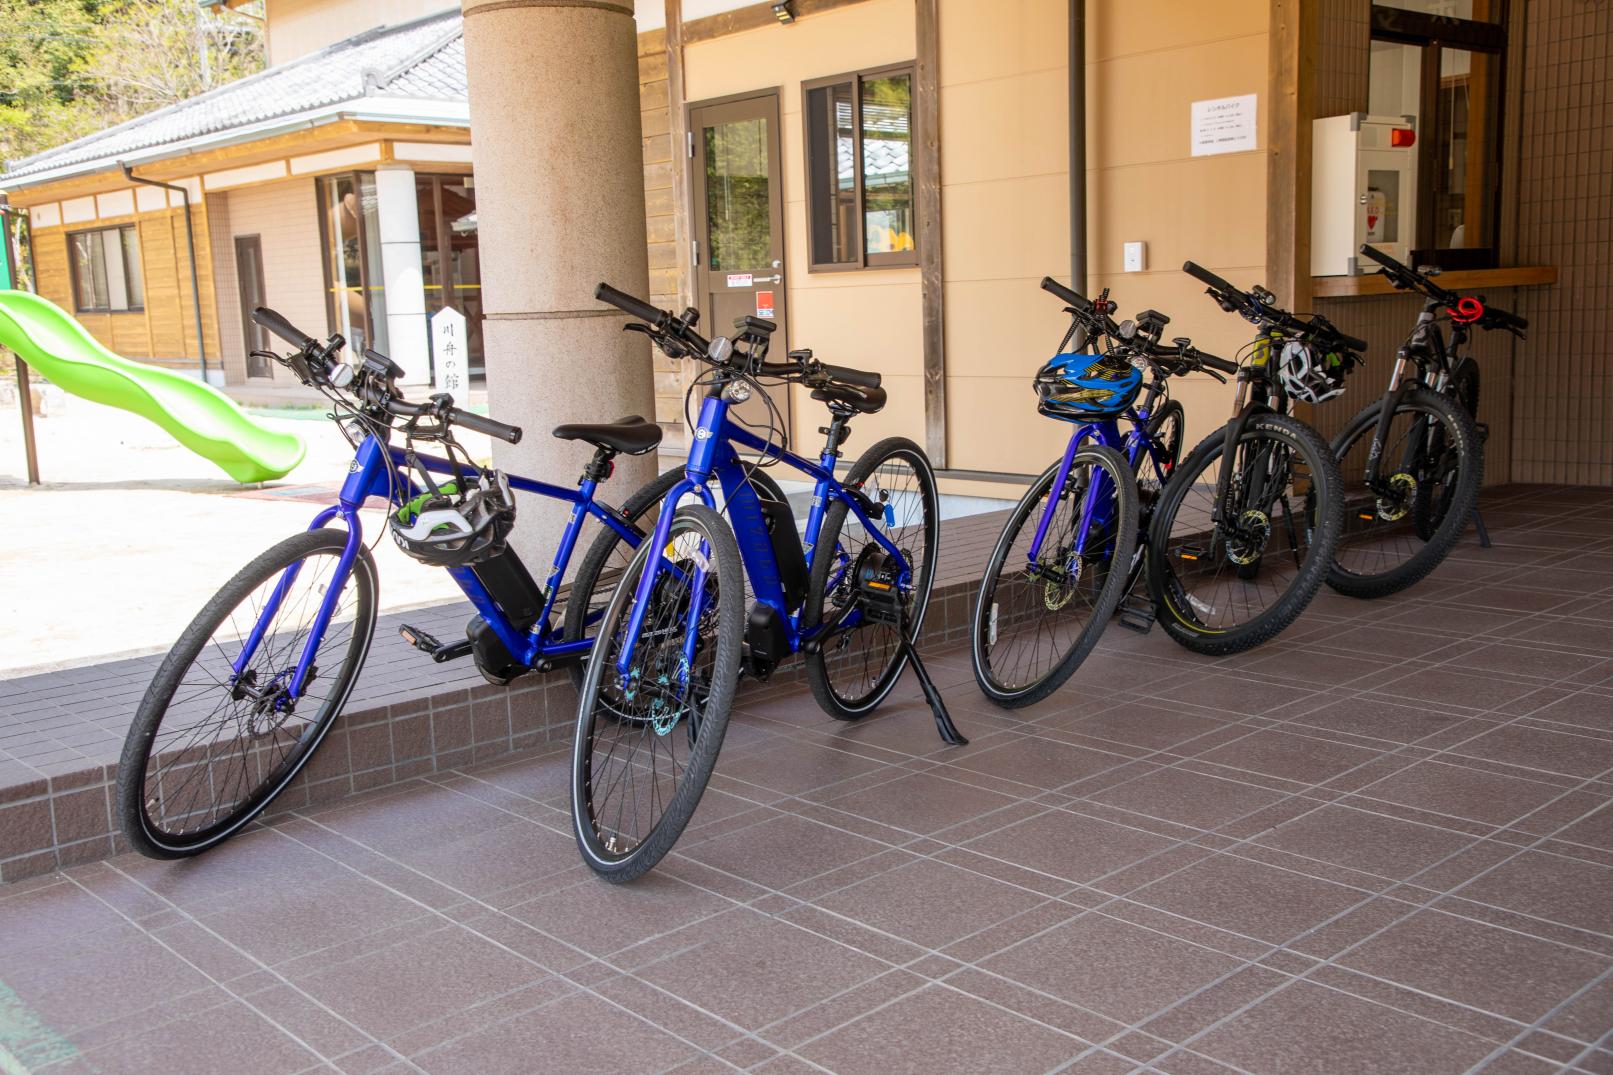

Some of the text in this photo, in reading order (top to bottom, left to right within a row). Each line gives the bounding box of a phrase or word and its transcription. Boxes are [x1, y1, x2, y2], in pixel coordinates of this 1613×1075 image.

[442, 322, 460, 391] 川舟の館
[1255, 423, 1297, 440] KENDA
